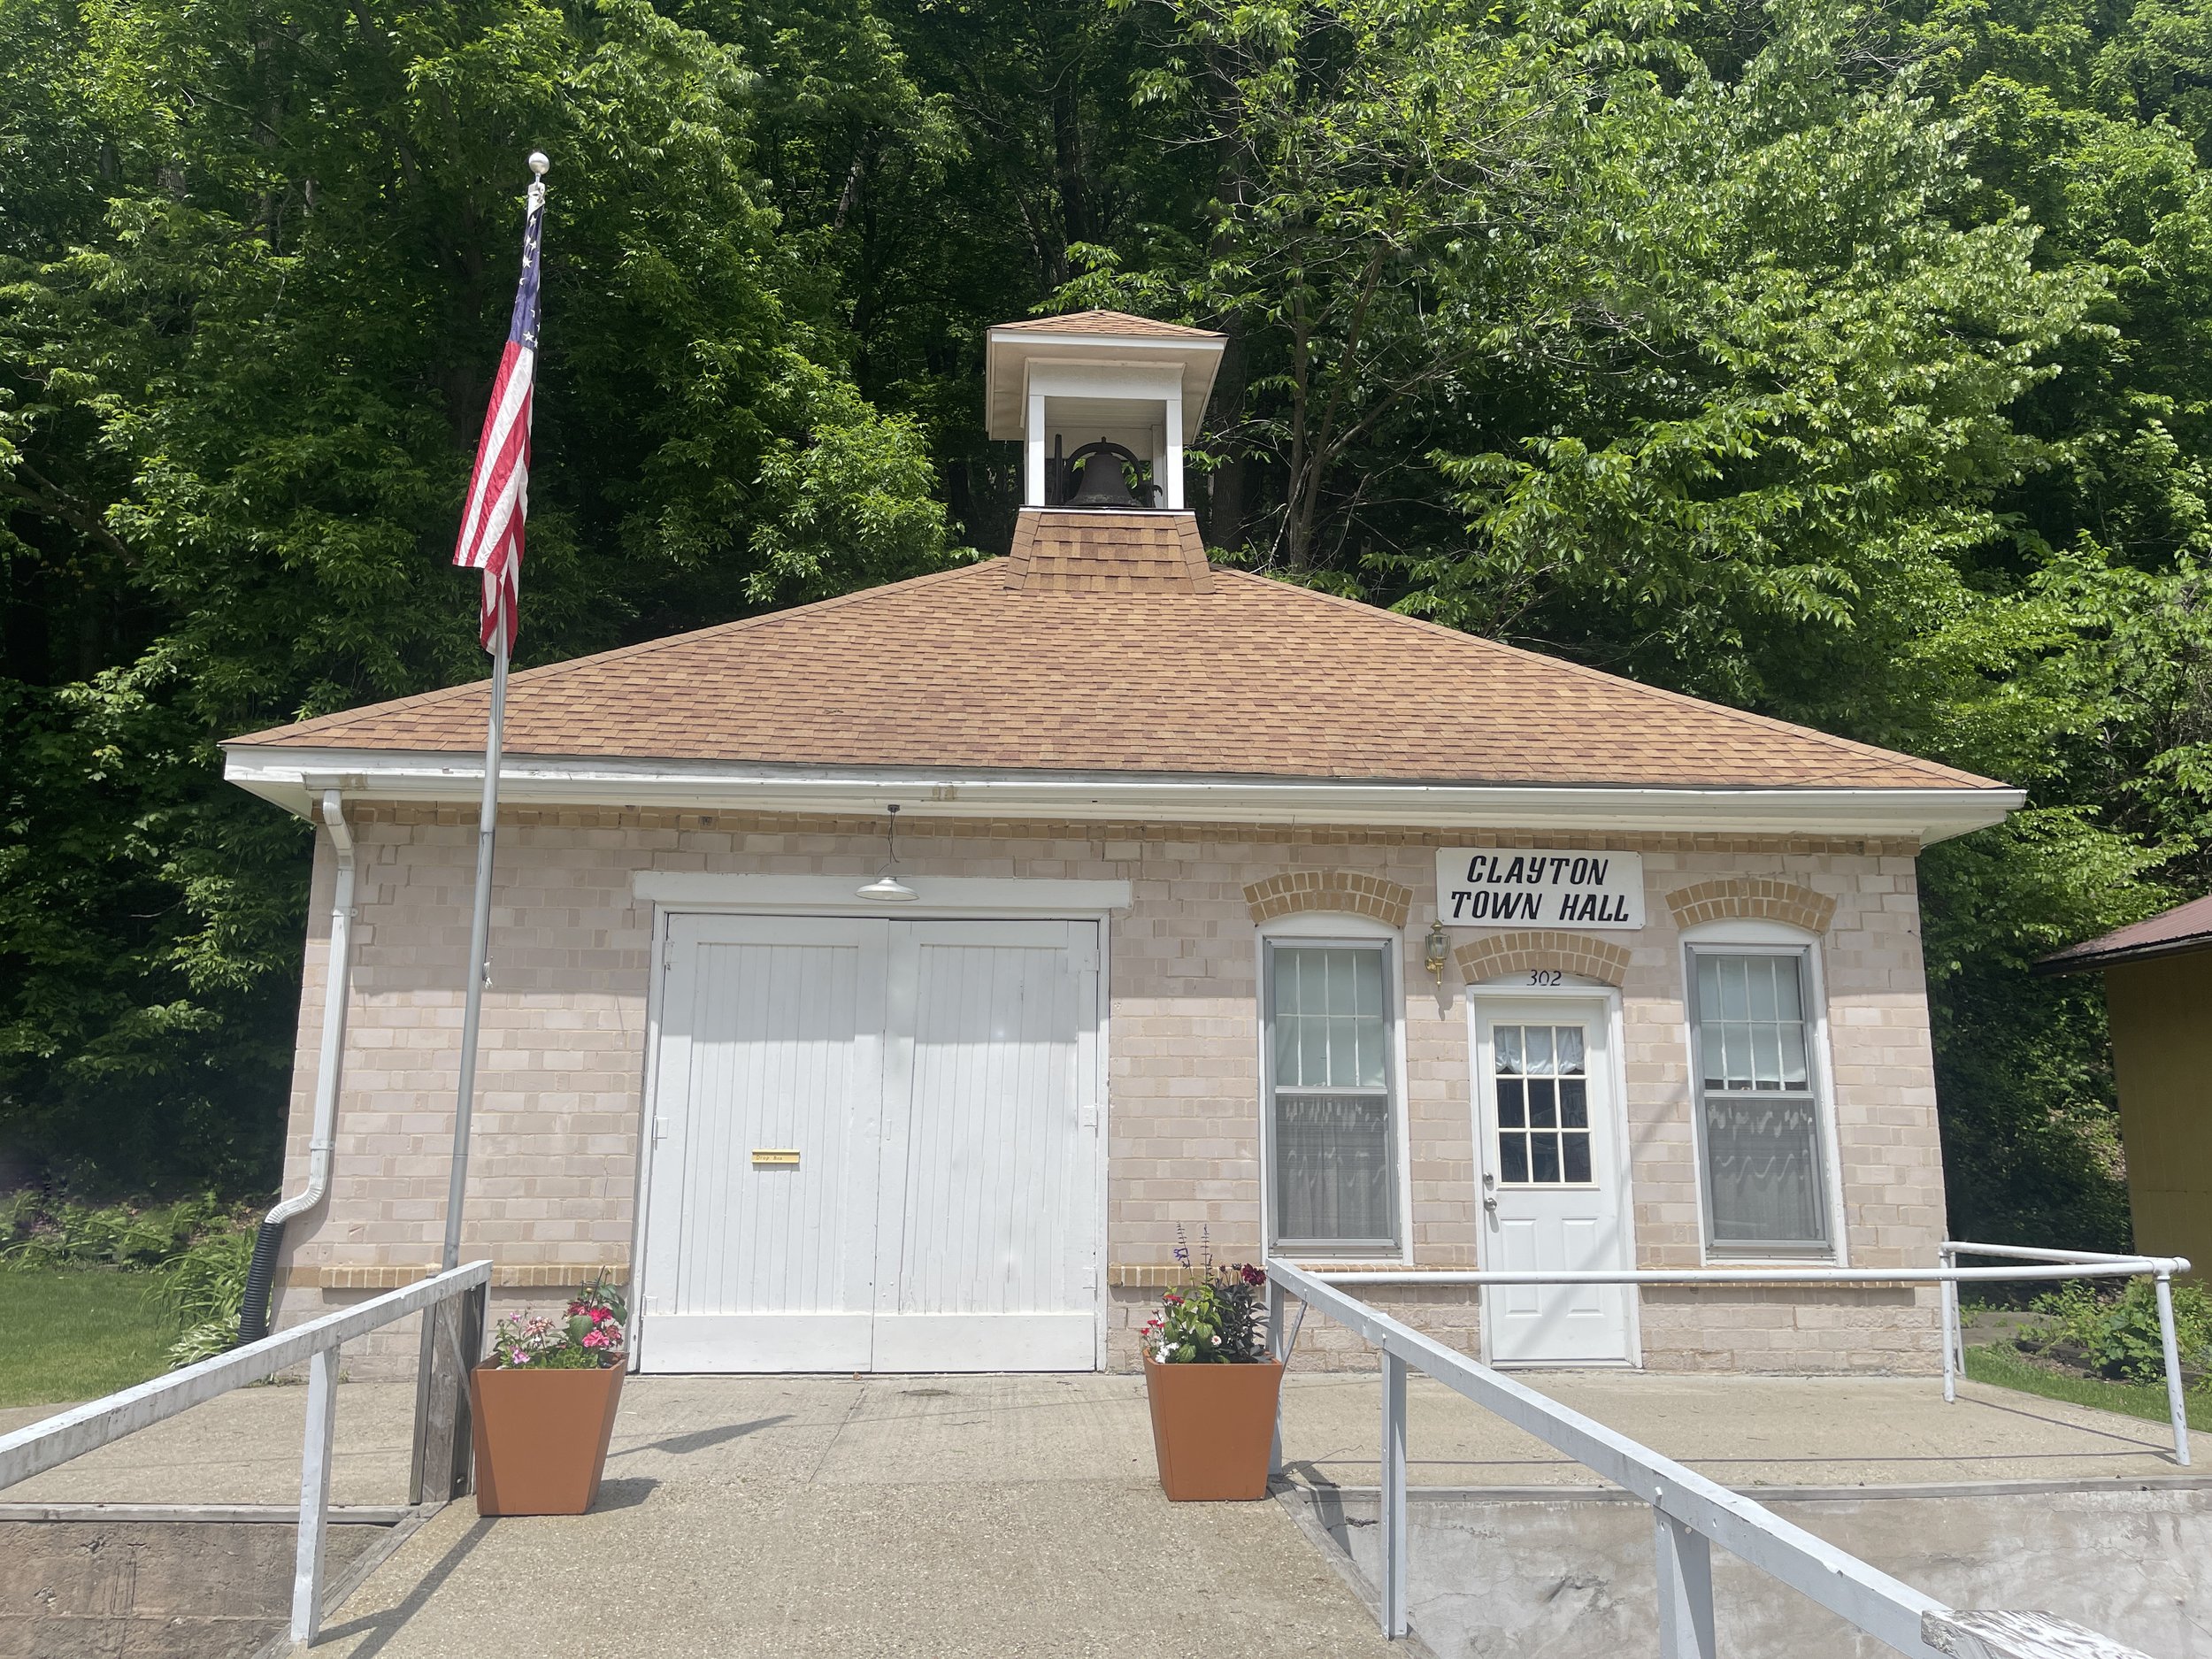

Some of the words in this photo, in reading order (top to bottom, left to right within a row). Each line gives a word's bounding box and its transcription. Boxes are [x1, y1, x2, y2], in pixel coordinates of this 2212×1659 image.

[1467, 855, 1609, 886] CLAYTON
[1451, 890, 1542, 919] TOWN
[1559, 894, 1629, 922] HALL
[1526, 969, 1562, 986] 302
